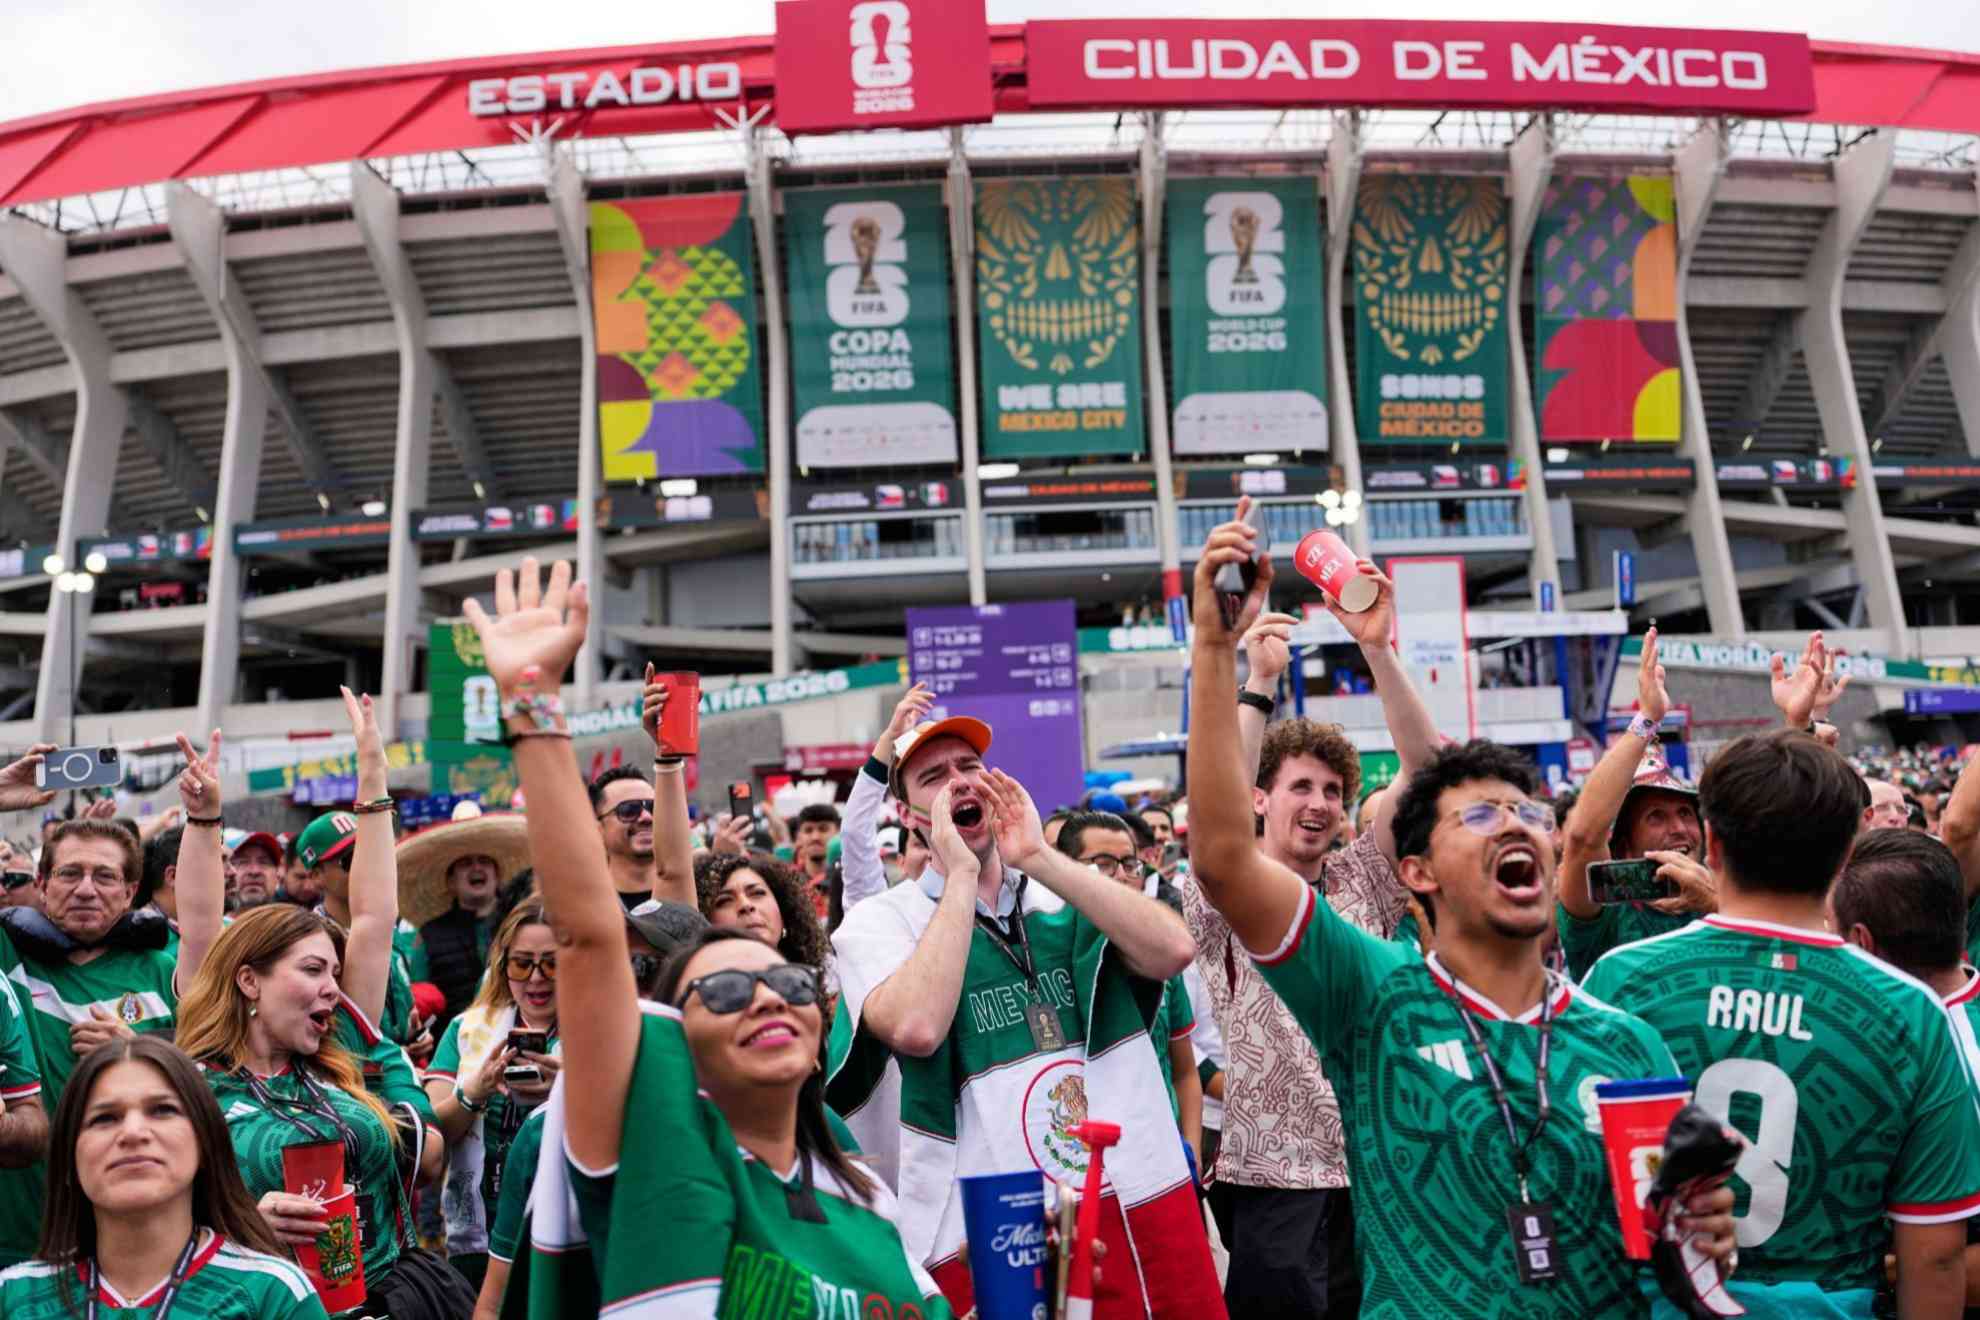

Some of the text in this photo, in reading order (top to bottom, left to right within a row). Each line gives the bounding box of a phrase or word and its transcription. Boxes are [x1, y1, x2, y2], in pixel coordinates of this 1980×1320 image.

[1084, 36, 1768, 90] CIUDAD DE MÉXICO
[468, 63, 741, 115] ESTADIO
[851, 301, 888, 315] FIFA
[1230, 290, 1264, 303] FIFA
[828, 328, 913, 355] COPA
[1207, 331, 1287, 352] 2026
[829, 354, 913, 371] MUNDIAL
[831, 369, 915, 392] 2026
[1380, 373, 1485, 400] SOMOS
[998, 384, 1053, 411] WE
[1380, 402, 1484, 419] CIUDAD DE
[1082, 409, 1126, 430] CITY
[710, 684, 763, 712] FIFA
[766, 670, 849, 704] 2026
[968, 967, 1077, 1034] MEXIC
[1707, 985, 1812, 1041] RAUL
[1694, 1057, 1798, 1248] 8
[333, 1262, 353, 1275] FIFA
